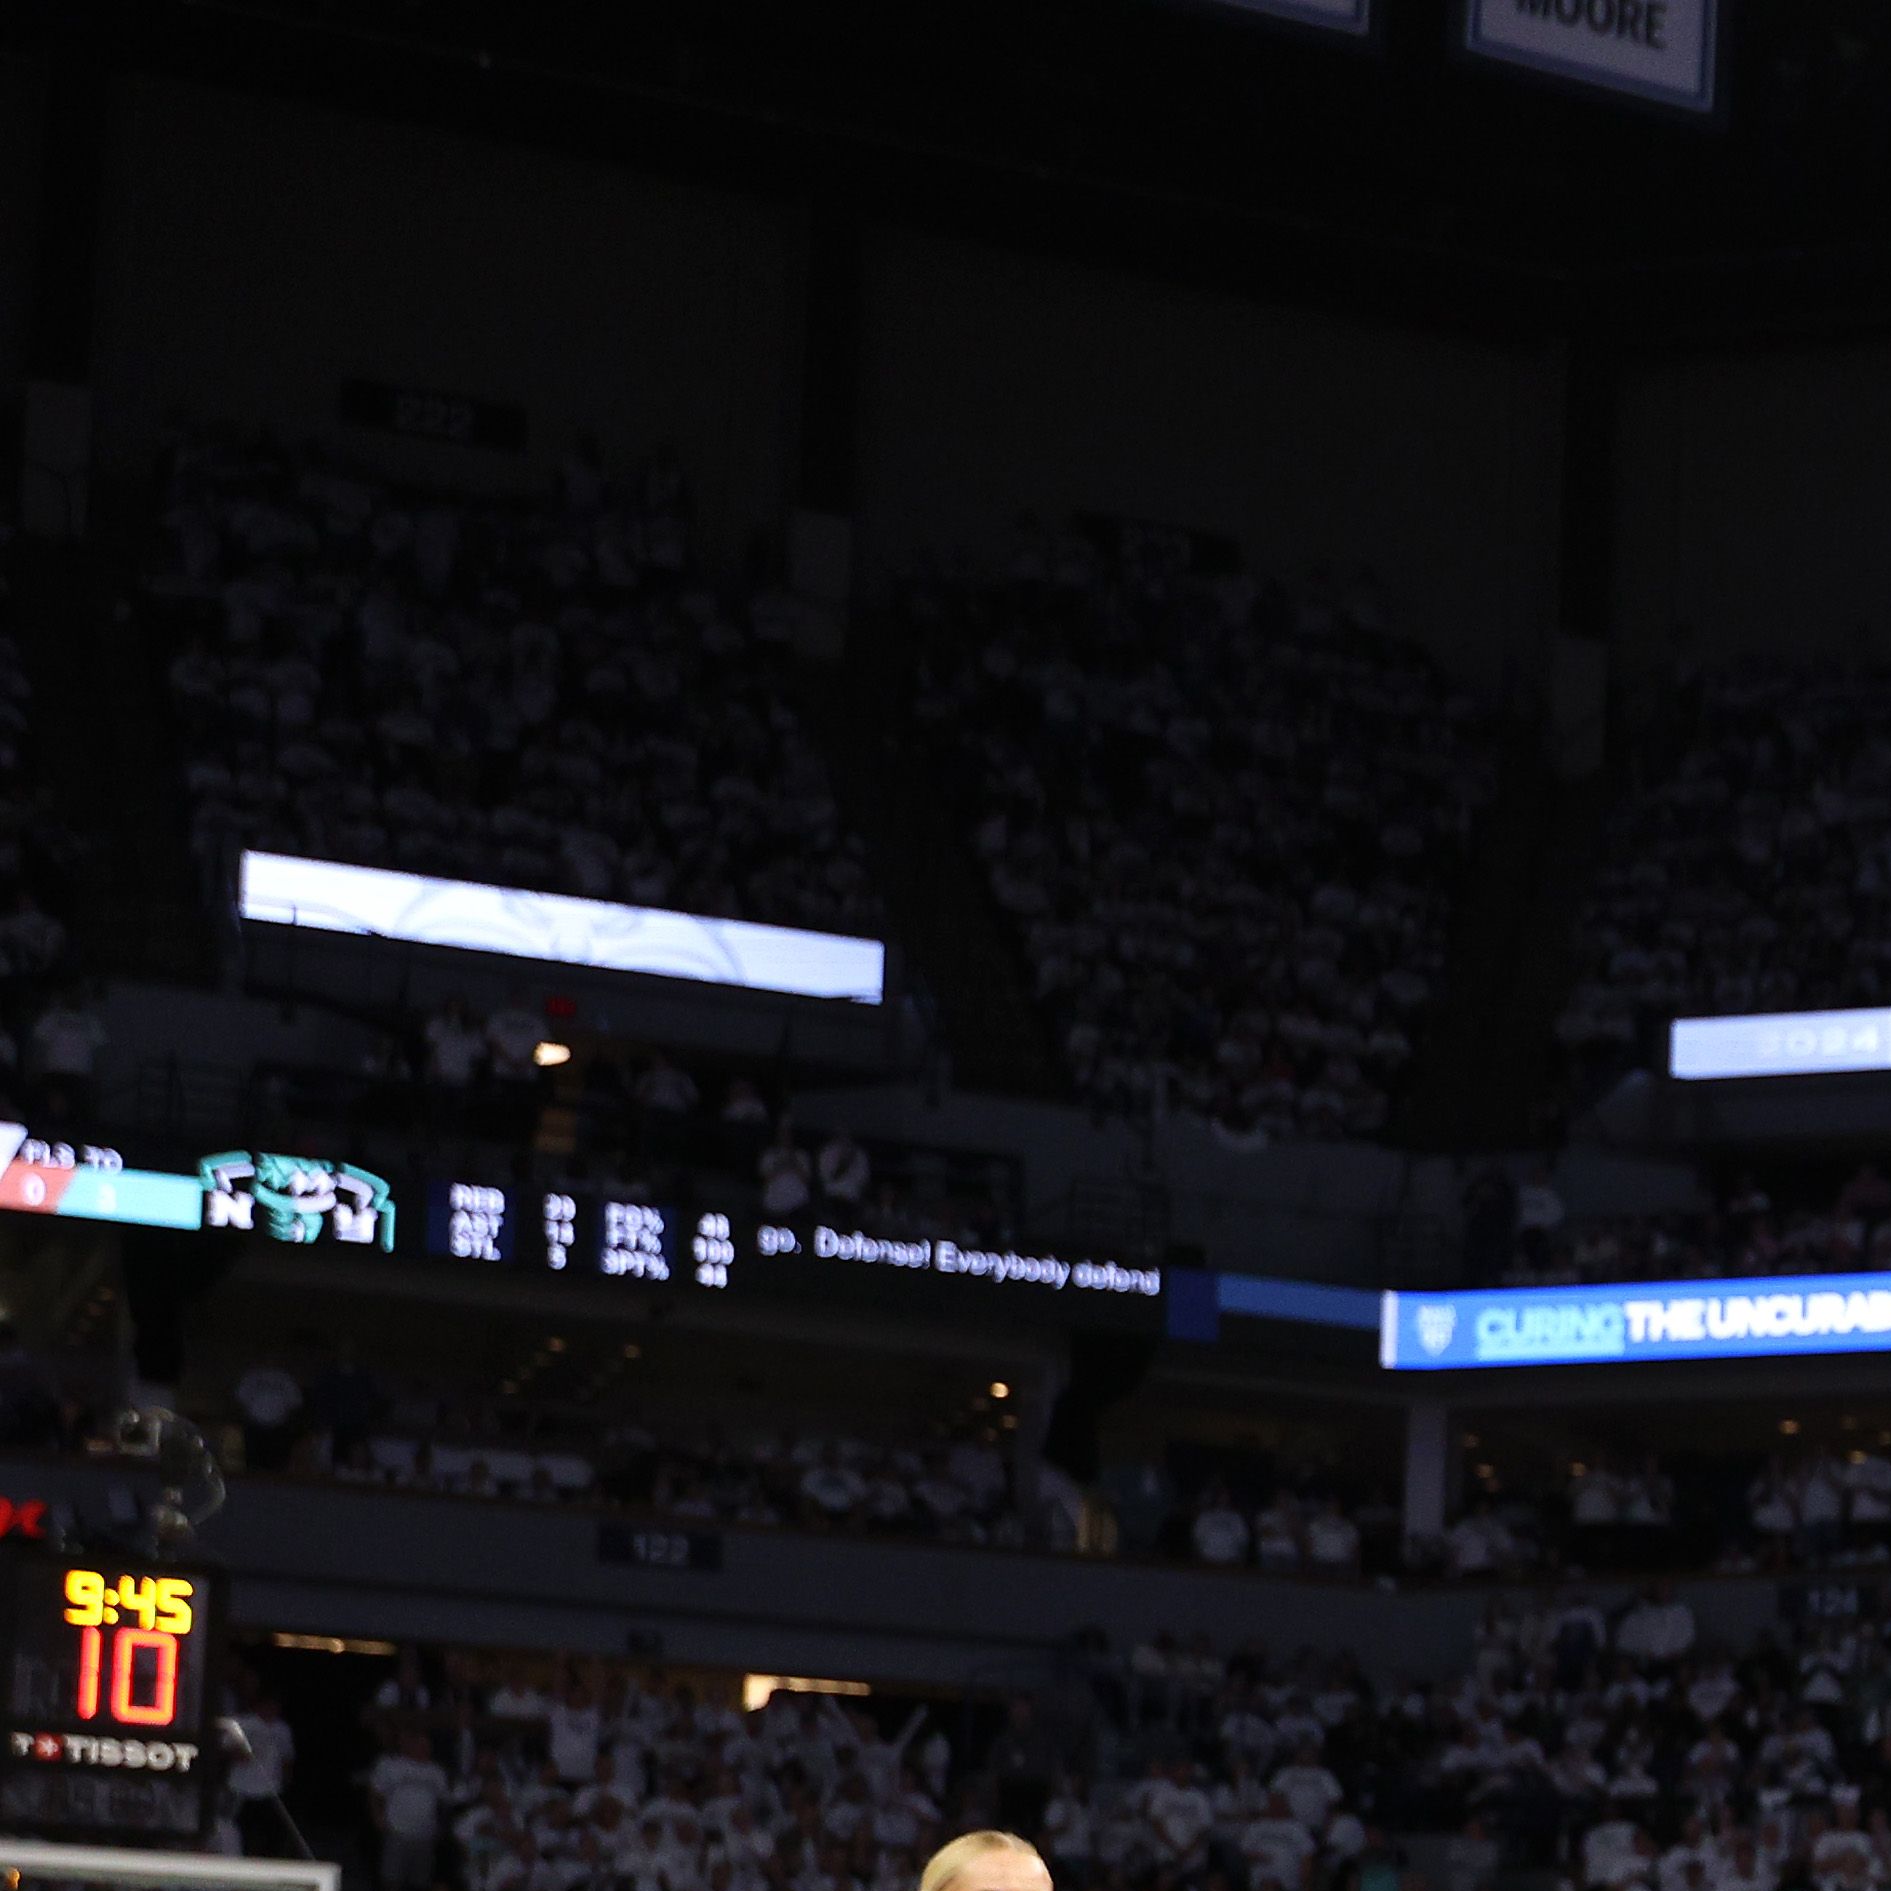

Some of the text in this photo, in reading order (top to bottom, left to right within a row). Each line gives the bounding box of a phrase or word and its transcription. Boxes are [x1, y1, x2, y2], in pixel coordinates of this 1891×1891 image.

[1623, 1299, 1704, 1342] THE
[64, 1569, 193, 1635] 9:45
[78, 1625, 178, 1726] 10
[62, 1733, 199, 1773] TISSOT
